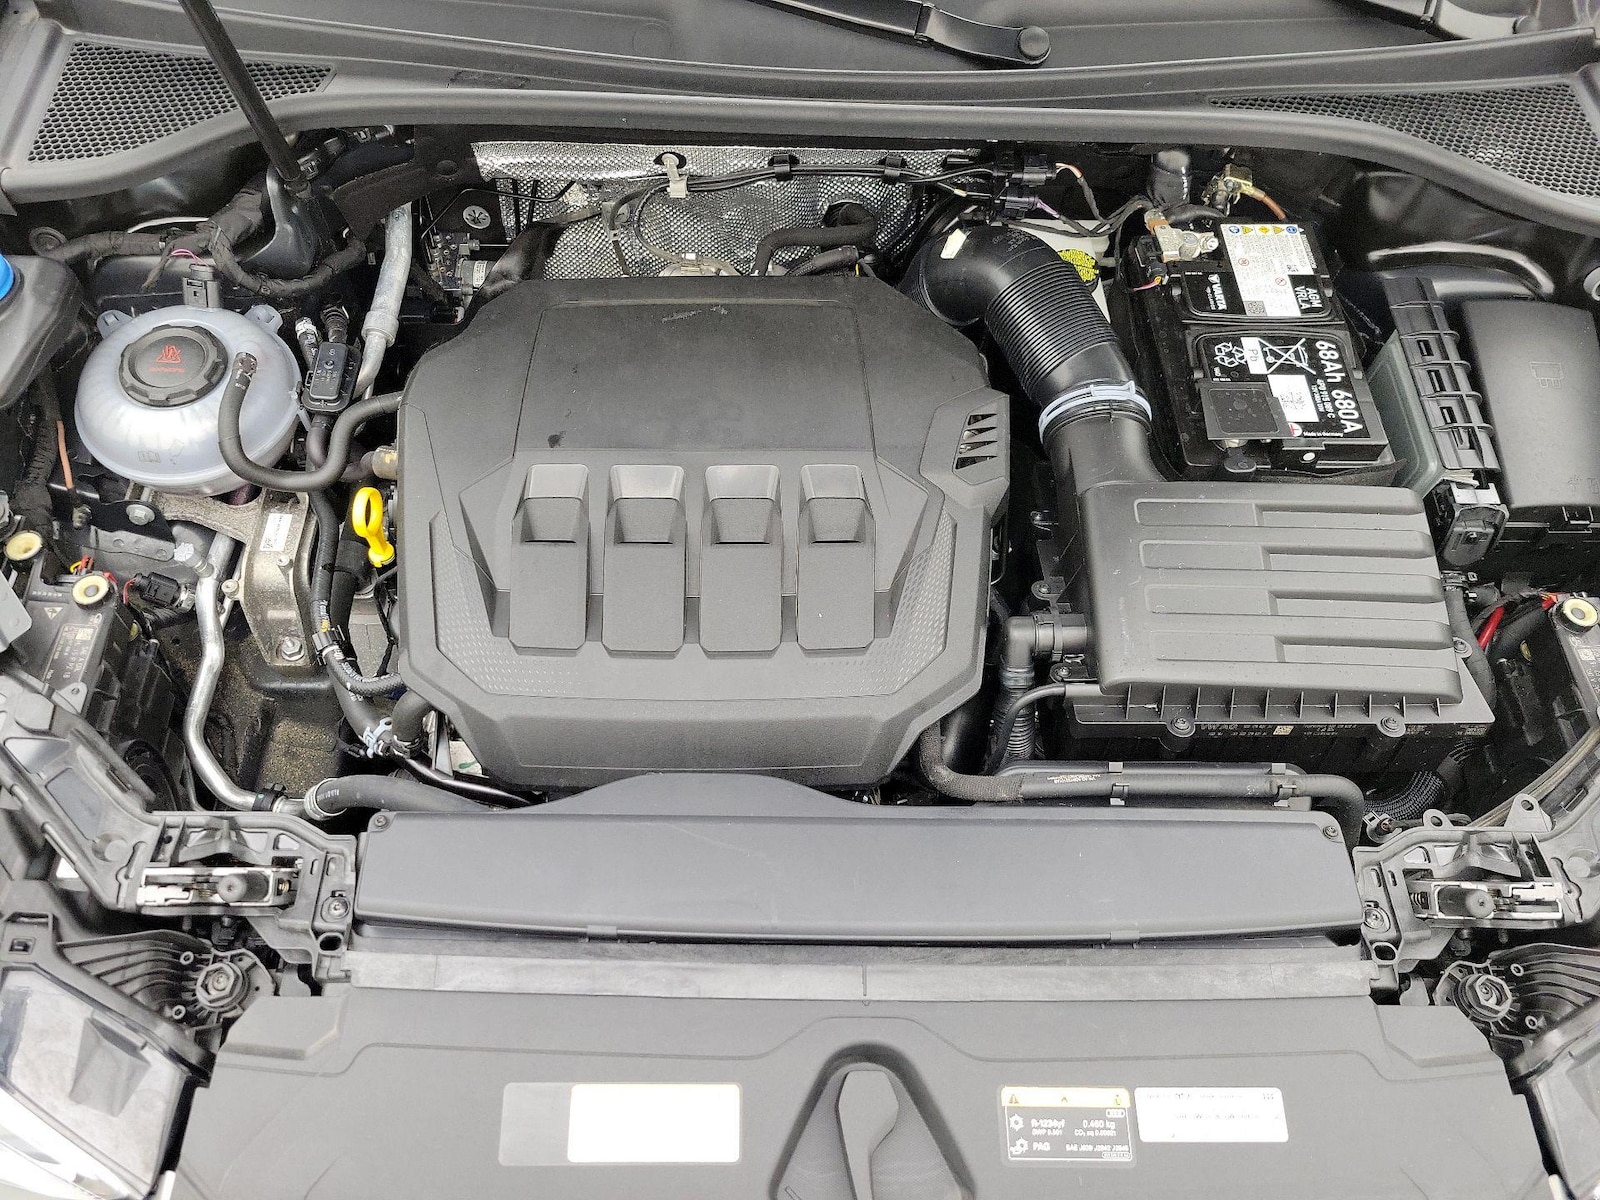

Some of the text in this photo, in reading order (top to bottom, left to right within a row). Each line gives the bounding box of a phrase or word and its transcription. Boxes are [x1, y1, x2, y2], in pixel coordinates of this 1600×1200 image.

[1212, 284, 1227, 310] VARTA
[1295, 286, 1310, 309] VRLA
[1306, 288, 1322, 307] AGM
[1250, 350, 1259, 362] Pb
[1315, 340, 1363, 433] 68Ah 680A
[1320, 391, 1330, 401] 915
[1106, 1120, 1116, 1129] kg
[1033, 1141, 1050, 1151] PAG
